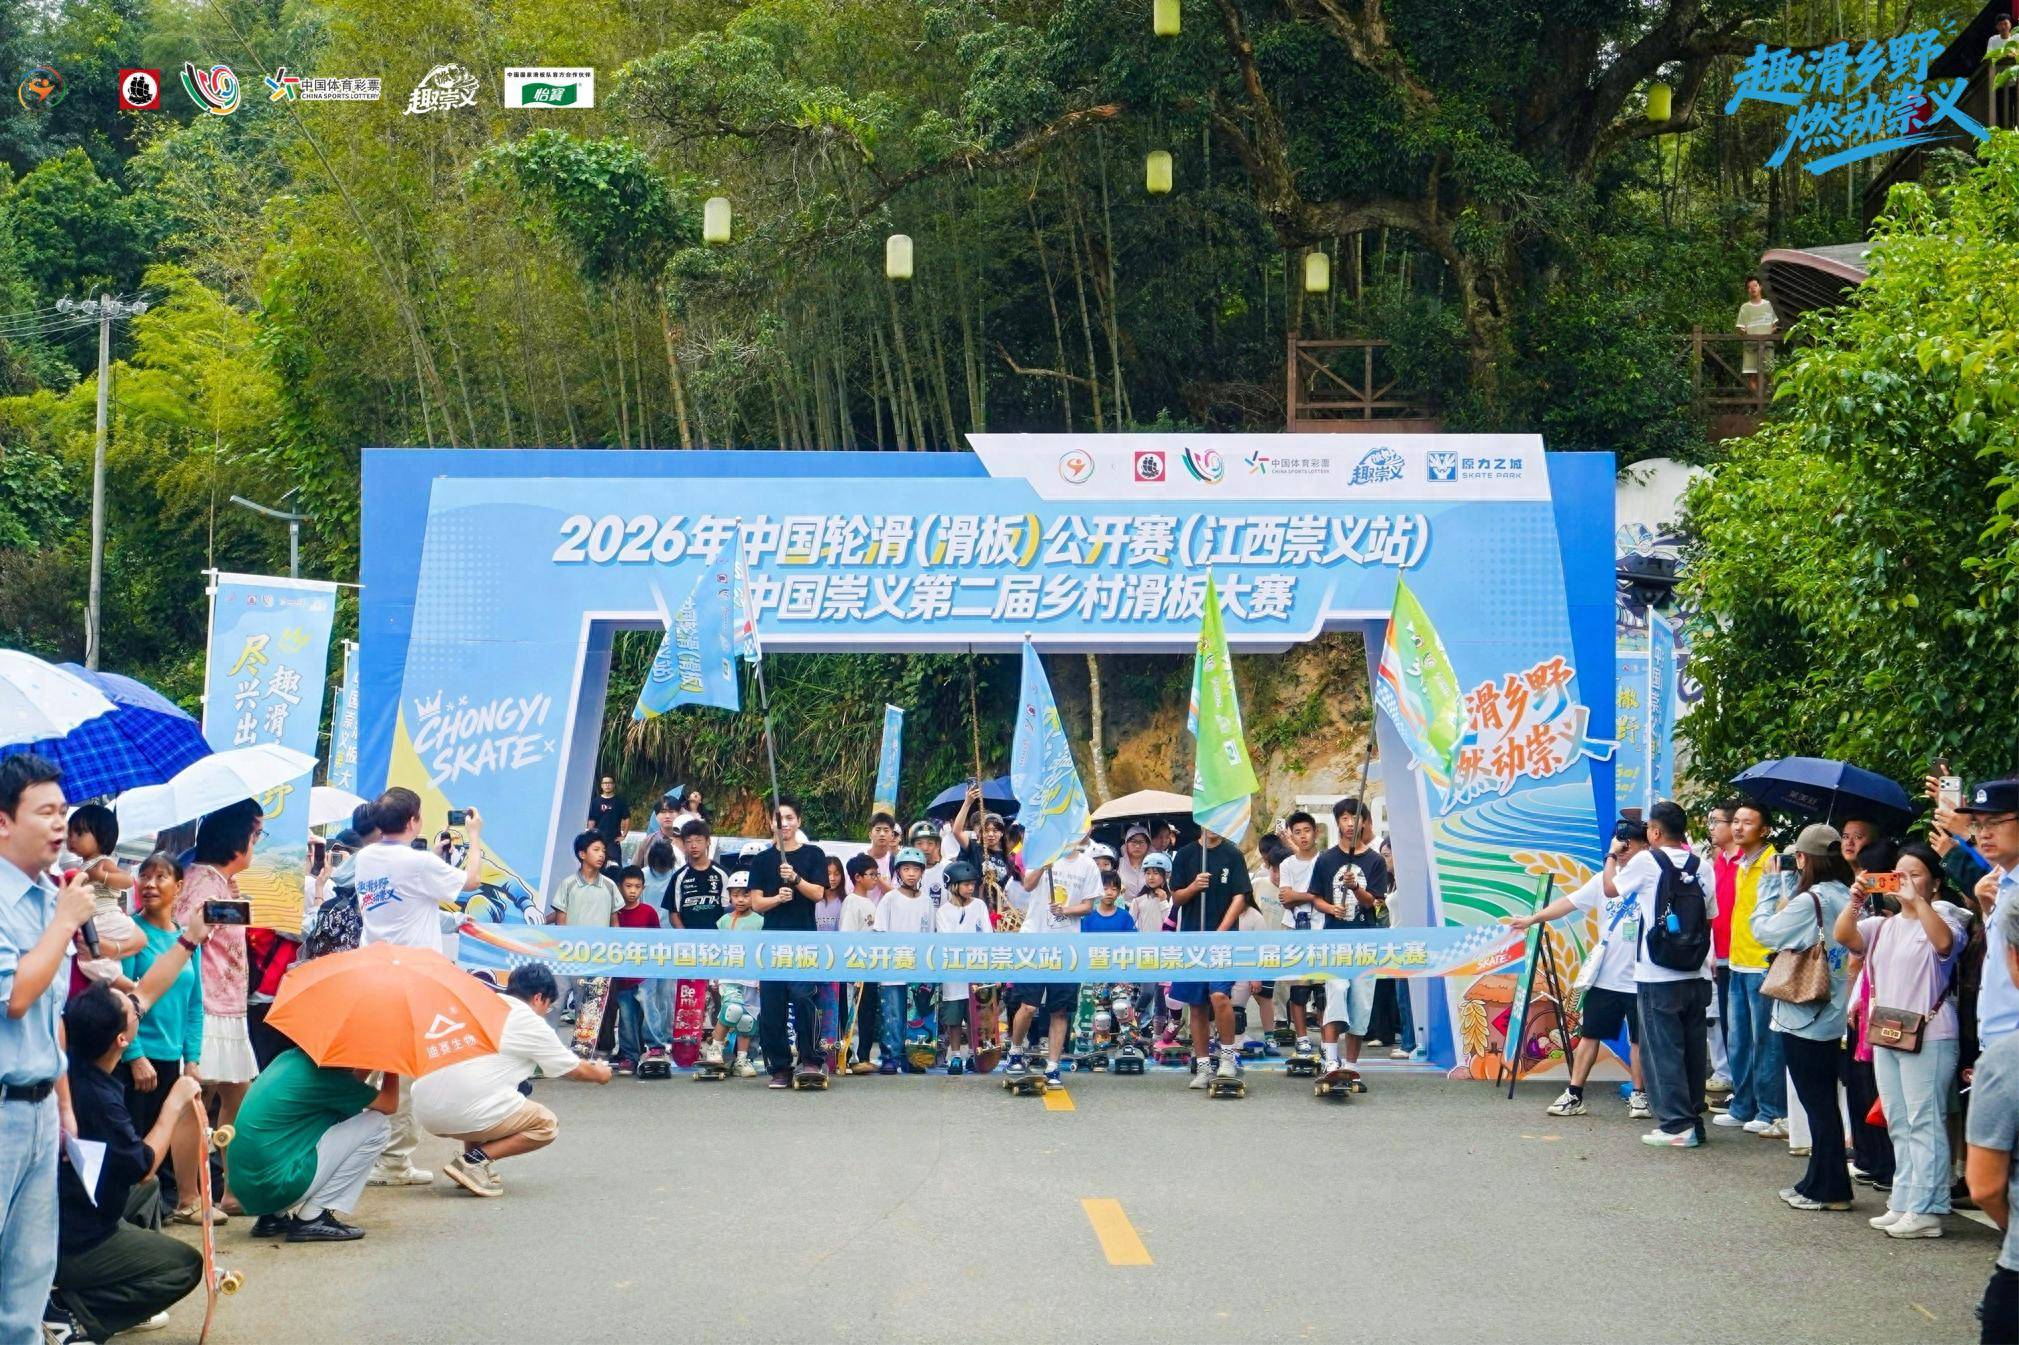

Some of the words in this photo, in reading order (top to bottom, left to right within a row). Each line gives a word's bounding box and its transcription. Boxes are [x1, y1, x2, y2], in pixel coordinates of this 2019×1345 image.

[1271, 458, 1330, 468] 中国体育彩票
[1347, 465, 1404, 486] 趣崇义
[1461, 458, 1523, 470] 原力之城
[697, 574, 1296, 621] 中国崇义第二届乡村滑板大赛
[413, 692, 553, 755] CHONGYI
[1462, 657, 1574, 746] 滑乡野
[426, 733, 545, 790] SKATE
